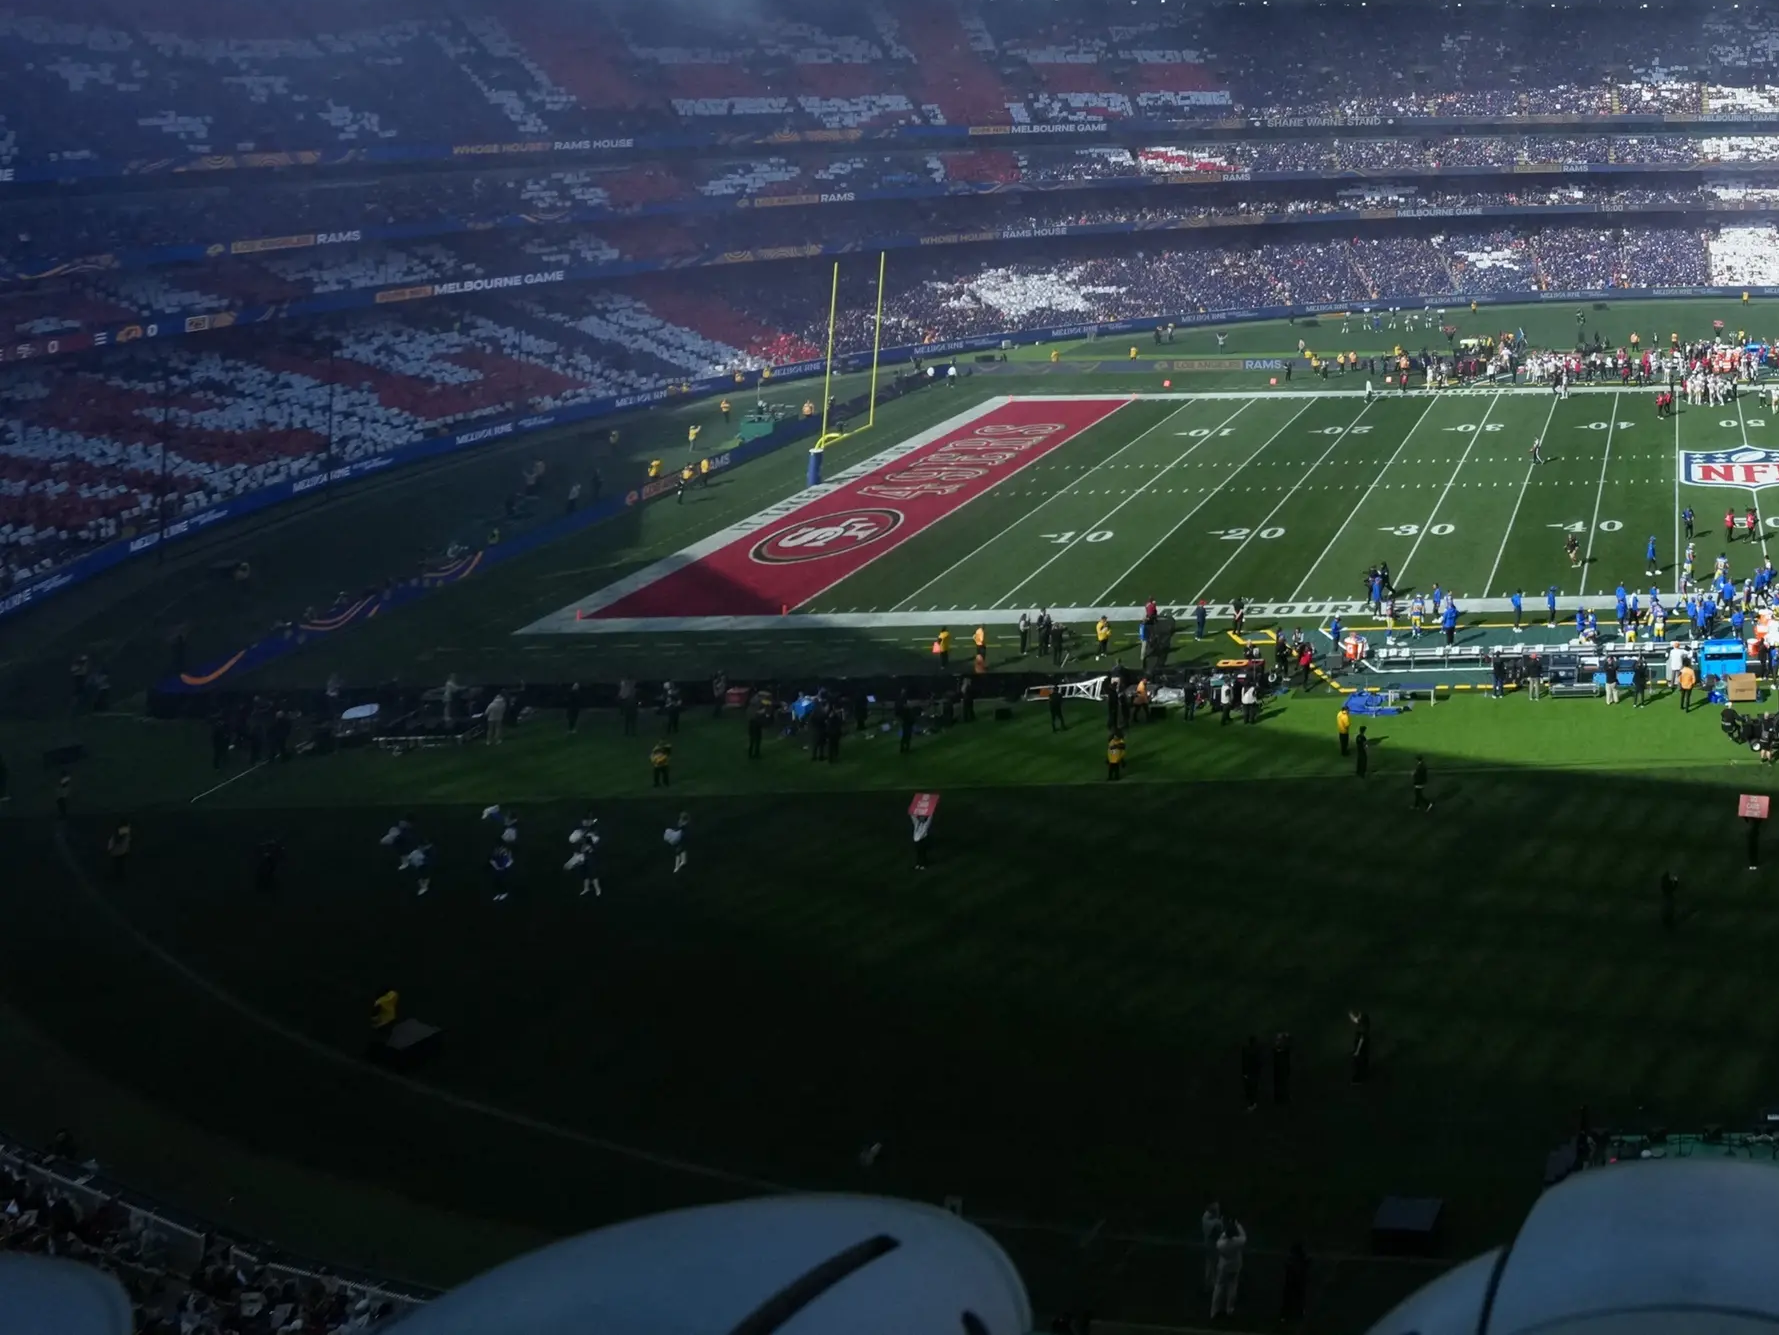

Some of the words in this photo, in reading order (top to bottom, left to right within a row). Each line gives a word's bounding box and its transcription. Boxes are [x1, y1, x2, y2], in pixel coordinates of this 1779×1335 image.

[1267, 117, 1303, 127] SHANE
[1306, 117, 1344, 126] WARNE
[1347, 117, 1381, 126] STAND
[1698, 114, 1750, 122] MELBOURNE
[1752, 114, 1777, 122] GAME
[1011, 125, 1075, 134] MELBOURNE
[1077, 124, 1107, 132] GAME
[554, 141, 590, 151] RAMS
[593, 139, 633, 149] HOUSE
[1563, 164, 1588, 172] RAMS
[1222, 174, 1250, 182] RAMS
[820, 193, 855, 203] RAMS
[1397, 209, 1453, 217] MELBOURNE
[1455, 207, 1482, 215] GAME
[317, 230, 361, 245] RAMS
[1002, 229, 1032, 239] RAMS
[1034, 227, 1067, 236] HOUSE
[434, 277, 521, 296] MELBOURNE
[524, 271, 564, 286] GAME
[48, 341, 59, 354] 0
[1245, 359, 1281, 369] RAMS
[857, 423, 1066, 500] 49ERS
[1393, 523, 1455, 536] 30
[1563, 520, 1623, 533] 40
[1050, 530, 1114, 544] 10
[1220, 527, 1286, 540] 20
